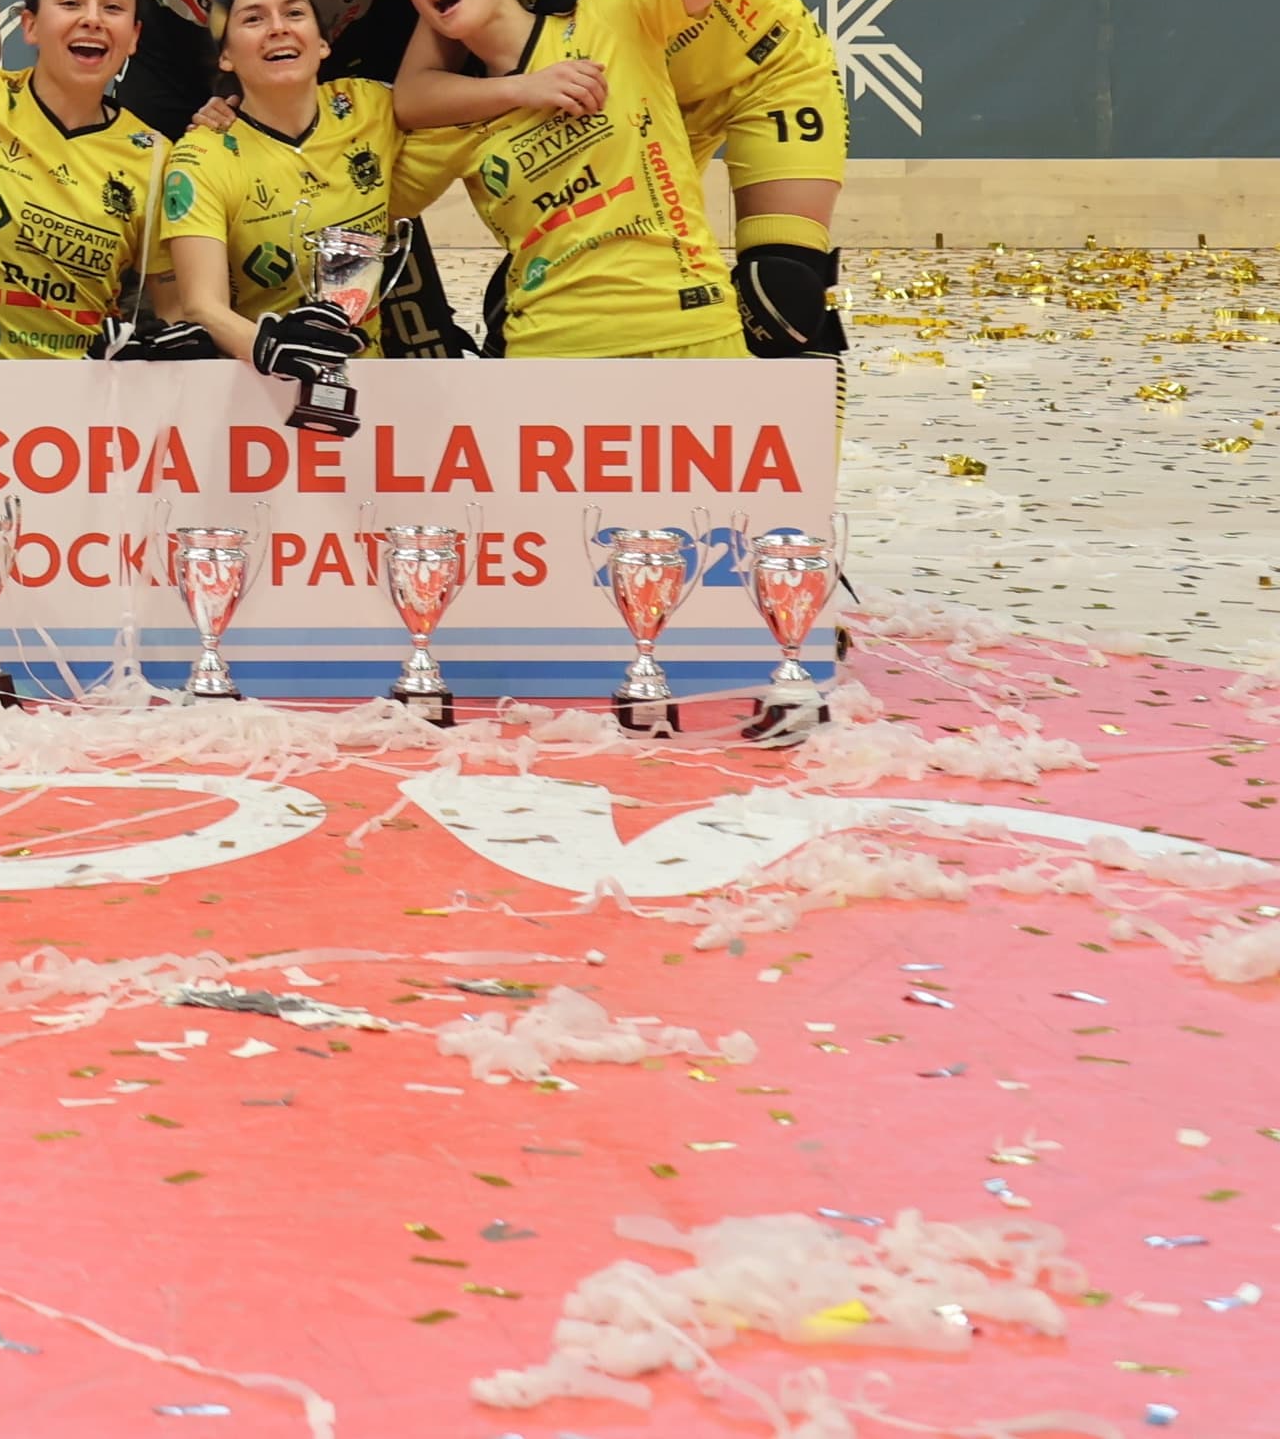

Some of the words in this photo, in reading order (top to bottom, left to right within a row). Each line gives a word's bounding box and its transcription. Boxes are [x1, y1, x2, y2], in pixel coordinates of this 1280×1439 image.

[514, 112, 610, 173] D'IVARS
[766, 106, 825, 143] 19
[531, 163, 602, 214] Pujol
[16, 223, 115, 273] D'IVARS
[19, 208, 119, 252] COOPERATIVA
[0, 259, 77, 304] Pujol
[228, 425, 348, 494] DE
[367, 426, 479, 494] LA
[519, 424, 803, 494] REINA
